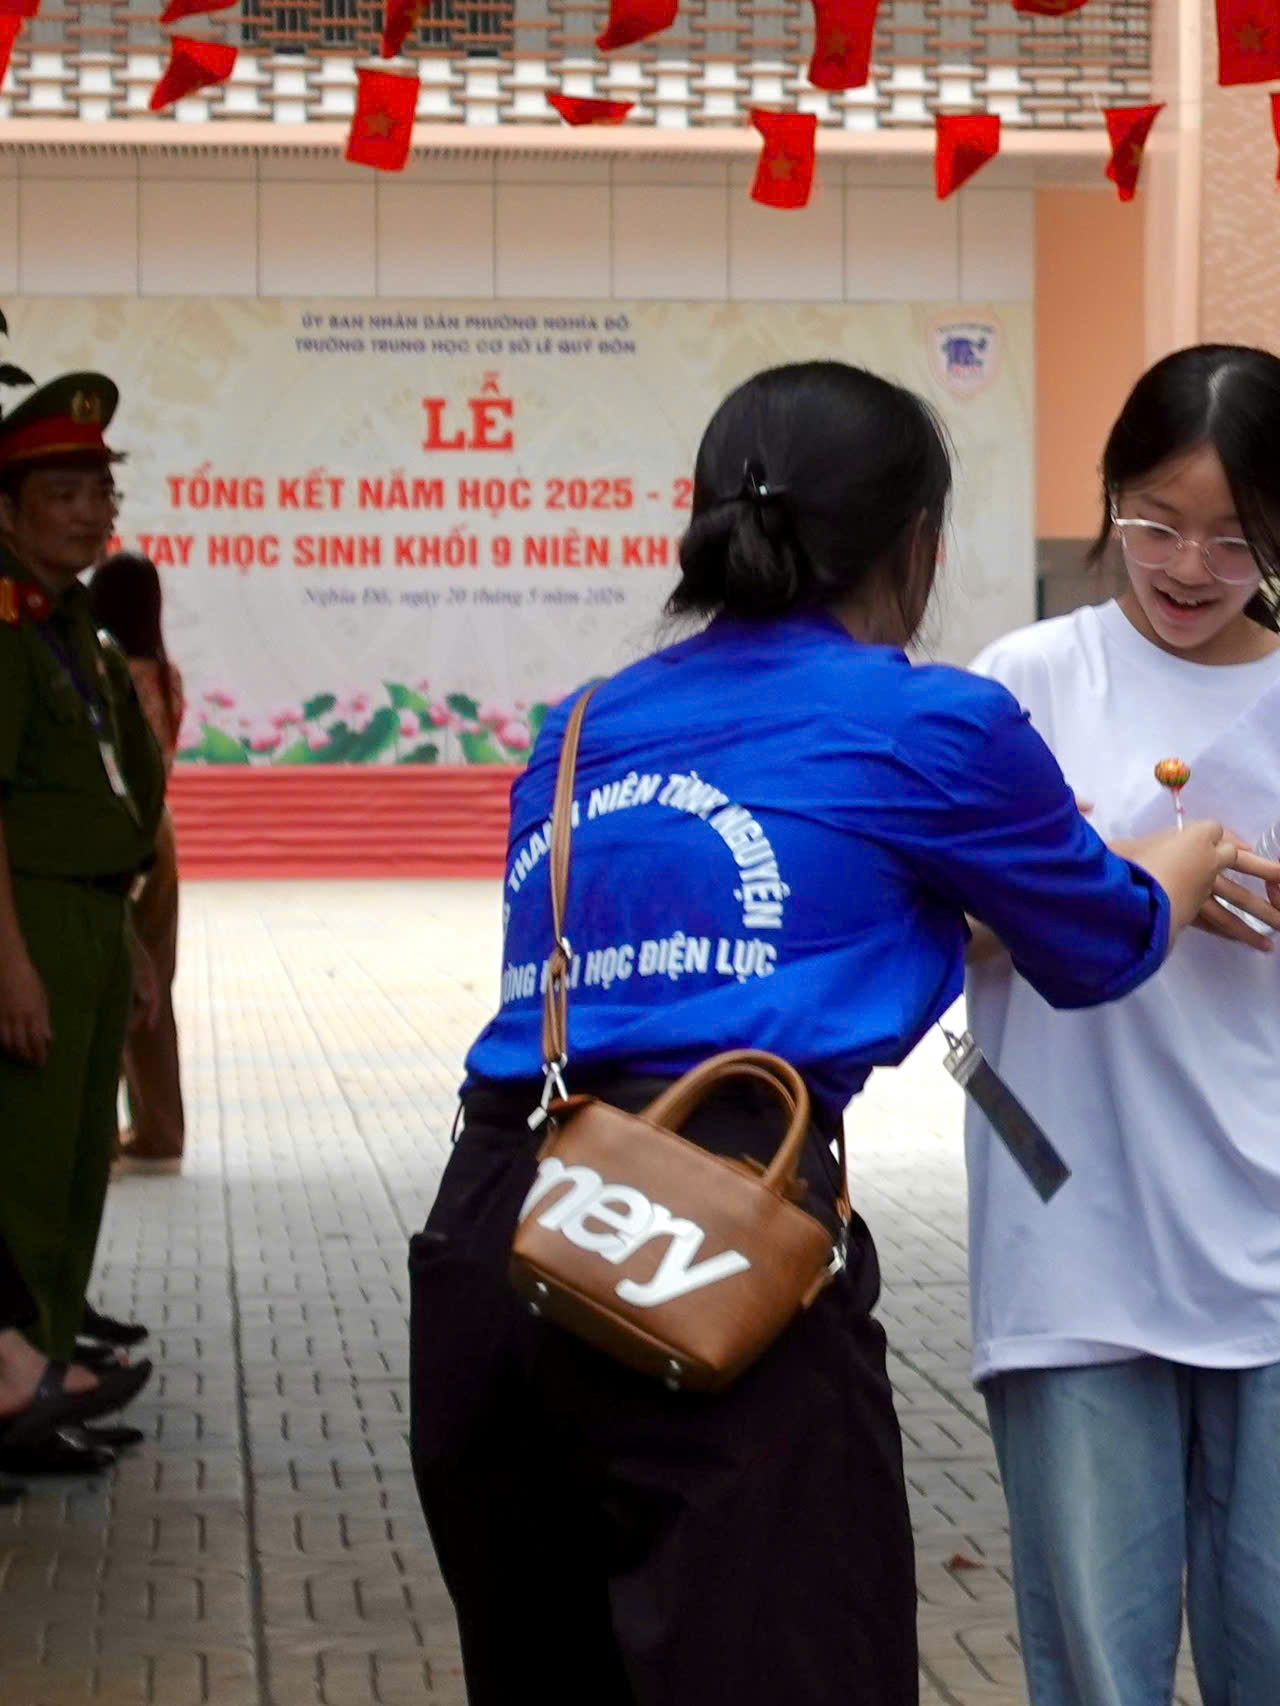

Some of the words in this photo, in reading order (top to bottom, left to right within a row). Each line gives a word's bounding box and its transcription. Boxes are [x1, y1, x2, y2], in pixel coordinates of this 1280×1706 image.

[329, 314, 364, 329] BAN
[371, 338, 427, 353] TRUNG
[422, 370, 514, 451] LỄ
[166, 461, 266, 511] TỔNG
[278, 465, 345, 511] KẾT
[358, 465, 445, 511] NĂM
[457, 477, 533, 520] HỌC
[545, 477, 635, 511] 2025
[137, 533, 196, 568] TAY
[207, 534, 281, 577] HỌC
[293, 534, 384, 568] SINH
[394, 522, 480, 569] KHỐI
[491, 535, 513, 569] 9
[523, 526, 611, 569] NIÊN
[621, 535, 684, 569] KH
[587, 770, 663, 821] NIÊN
[708, 803, 791, 930] NGUYỆN
[584, 943, 635, 990] HỌC
[638, 930, 711, 982] ĐIỆN
[715, 936, 778, 984] LỰC
